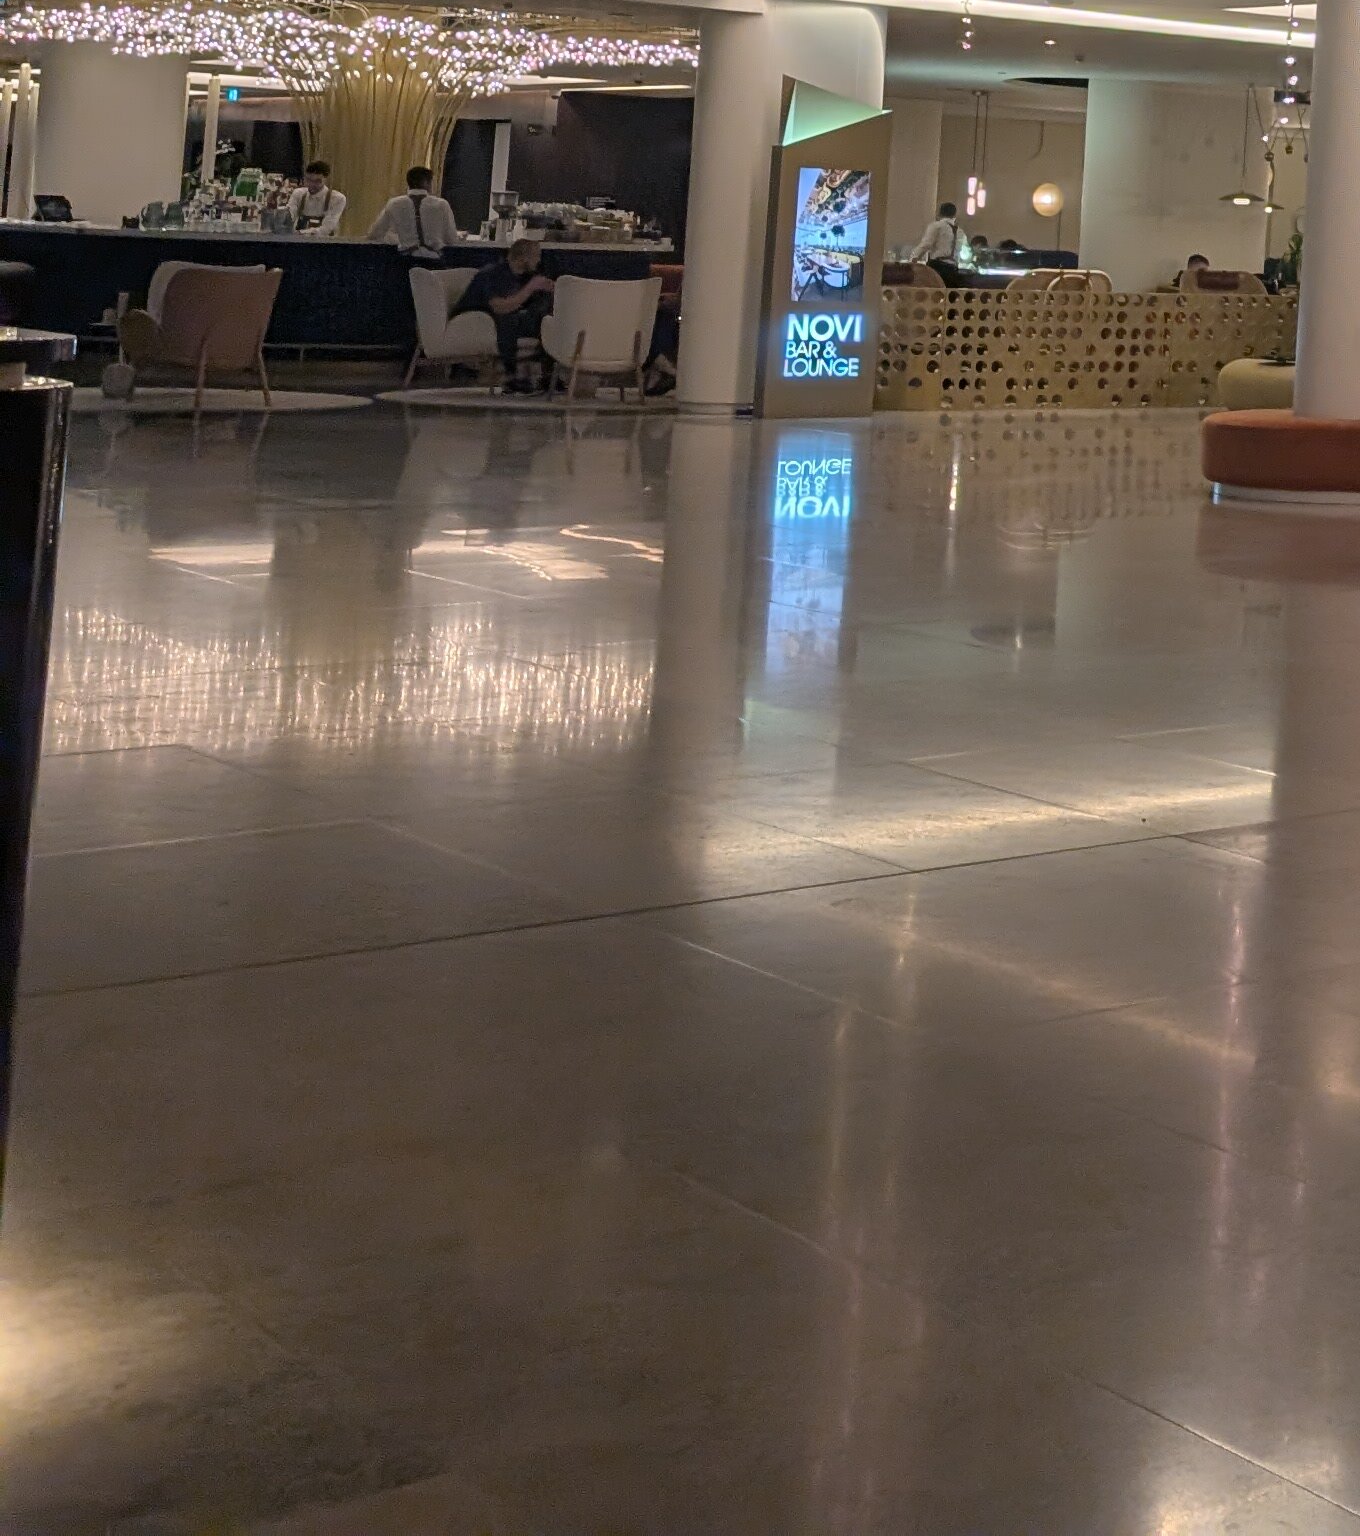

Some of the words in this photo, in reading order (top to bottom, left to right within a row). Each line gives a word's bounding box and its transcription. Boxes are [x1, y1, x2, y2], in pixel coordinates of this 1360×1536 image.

[786, 313, 863, 342] NOVI
[785, 340, 820, 359] BAR
[822, 340, 838, 359] &
[783, 357, 860, 378] LOUNGE
